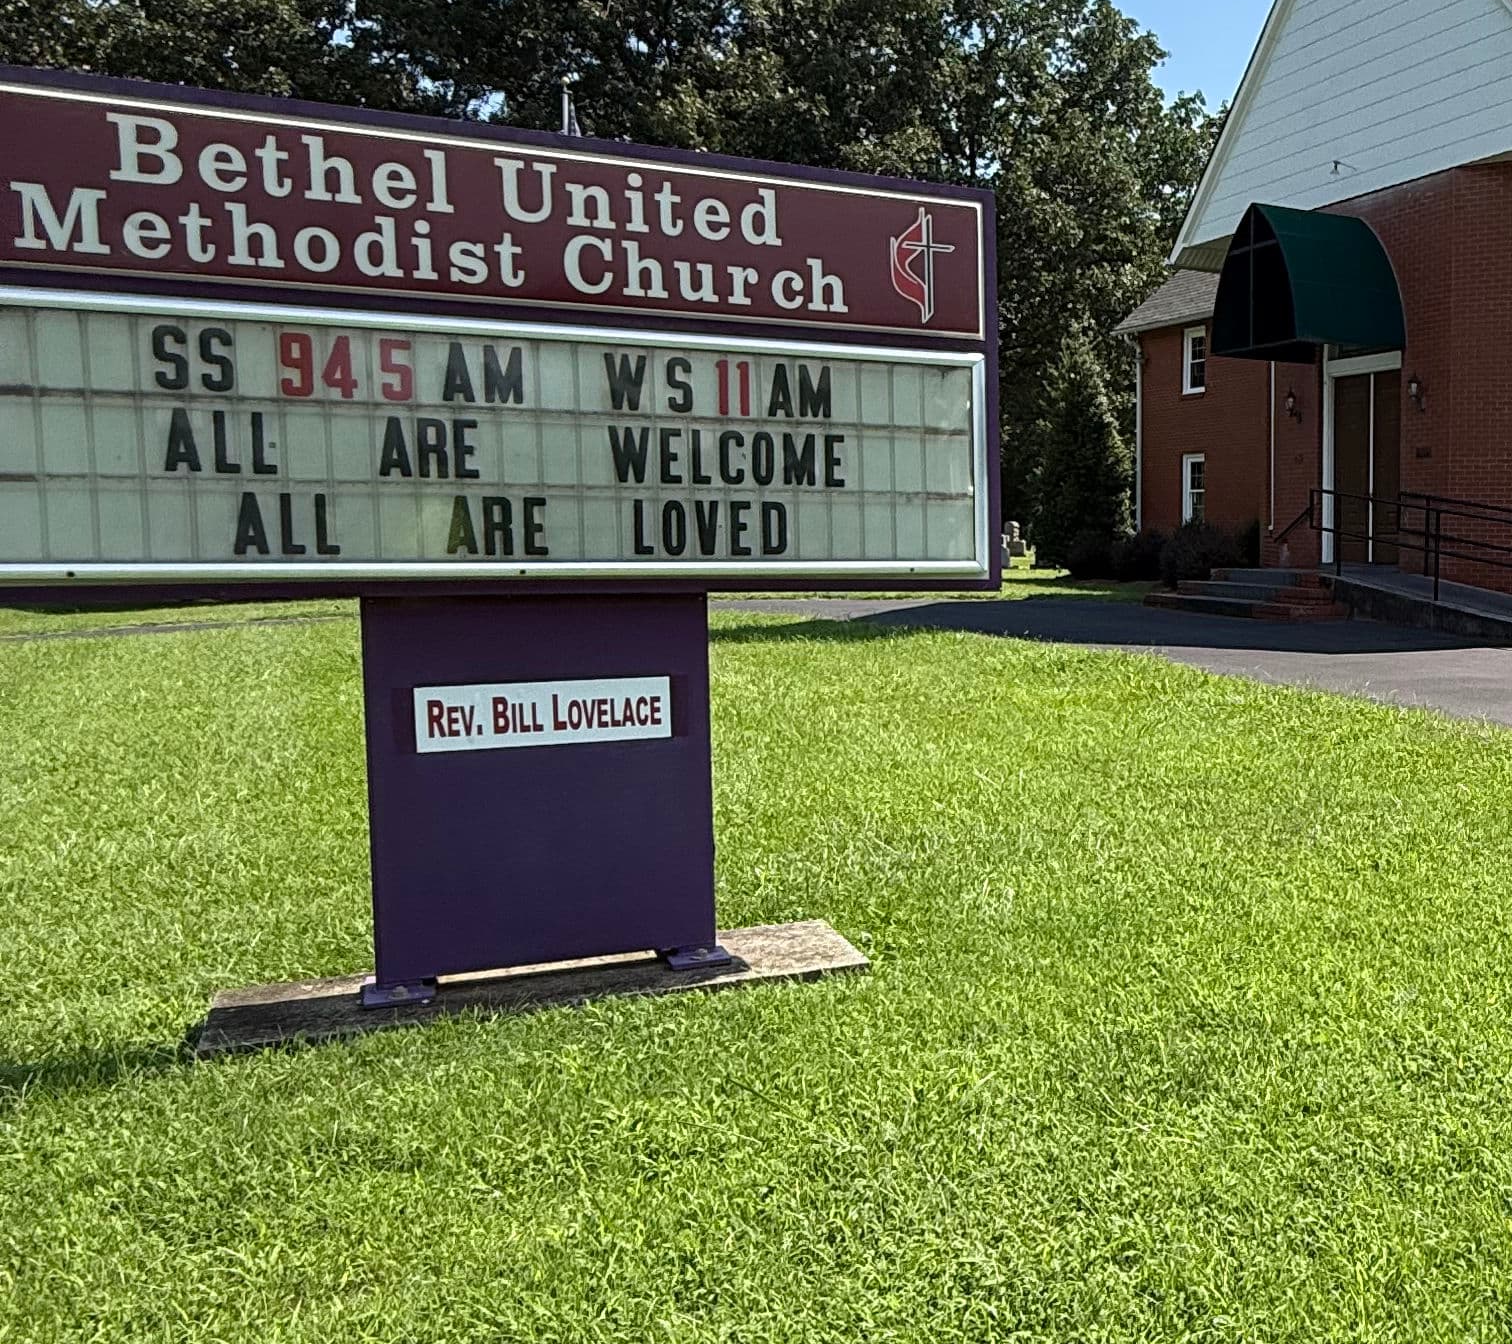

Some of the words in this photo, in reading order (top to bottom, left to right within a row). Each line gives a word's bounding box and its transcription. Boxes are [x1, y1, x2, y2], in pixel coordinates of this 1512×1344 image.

[106, 111, 455, 214] Bethel
[494, 157, 782, 246] United
[10, 181, 525, 287] Methodist
[563, 235, 849, 313] Church
[152, 324, 234, 393] SS
[279, 332, 414, 402] 945
[442, 342, 524, 404] AM
[714, 359, 750, 417] 11
[767, 363, 832, 419] AM
[164, 408, 278, 475] ALL
[379, 416, 480, 479] ARE
[608, 425, 846, 488] WELCOME
[233, 491, 341, 555] ALL
[446, 494, 550, 556] ARE
[633, 498, 788, 556] LOVED
